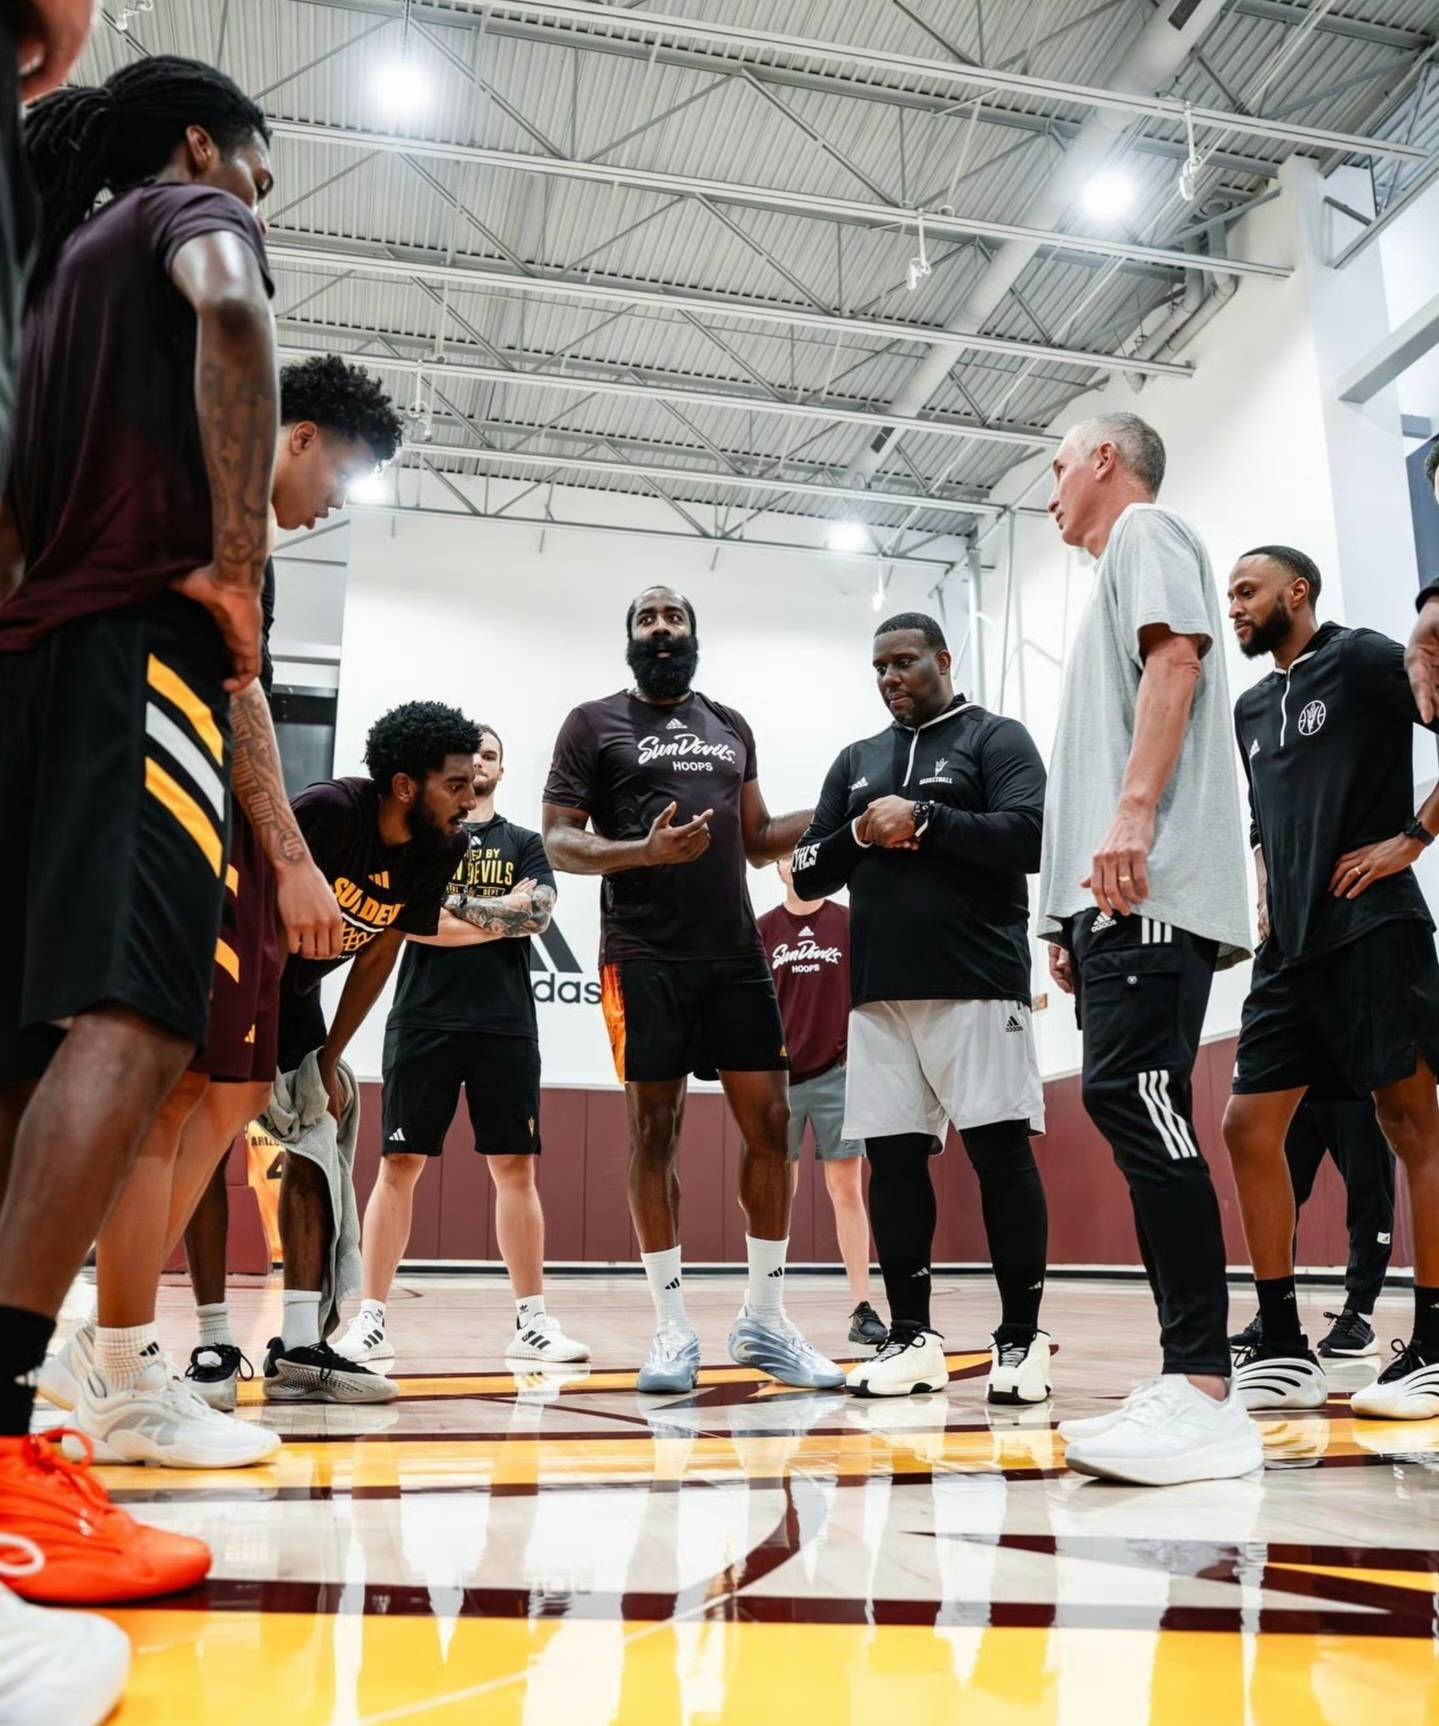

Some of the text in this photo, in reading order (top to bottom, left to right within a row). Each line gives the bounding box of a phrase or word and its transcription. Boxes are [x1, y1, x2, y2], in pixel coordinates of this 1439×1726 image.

[672, 761, 713, 772] HOOPS
[485, 848, 501, 859] BY
[467, 859, 514, 886] DEVILS
[334, 876, 405, 926] SU DEV
[791, 963, 821, 974] HOOPS
[532, 973, 602, 1005] das
[251, 1136, 280, 1147] ARI
